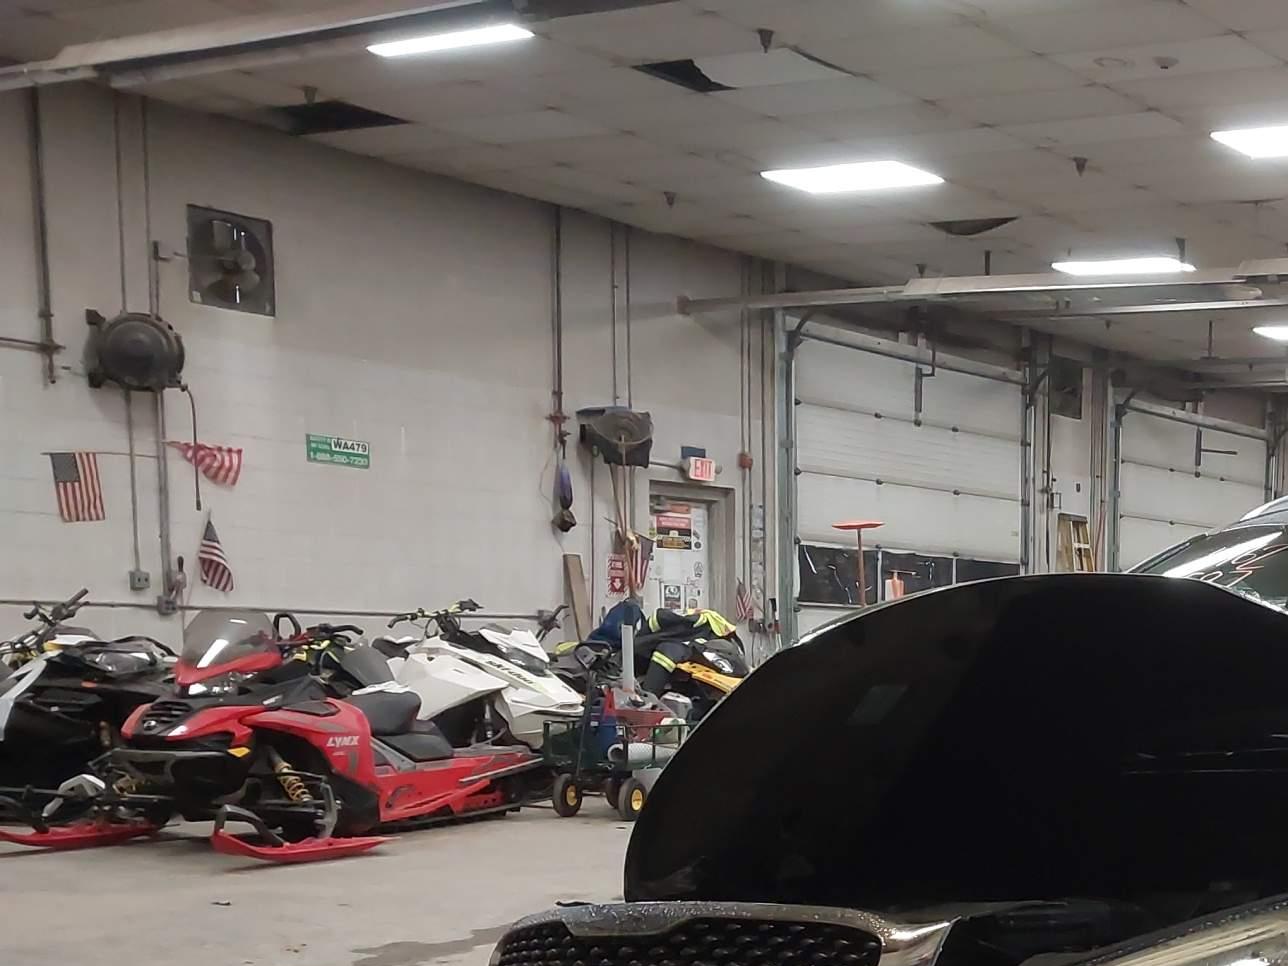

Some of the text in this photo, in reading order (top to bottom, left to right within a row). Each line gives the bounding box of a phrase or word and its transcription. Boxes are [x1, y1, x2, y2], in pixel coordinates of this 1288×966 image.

[332, 438, 368, 454] WA479
[694, 458, 713, 479] EXIT
[326, 735, 360, 748] LYNX
